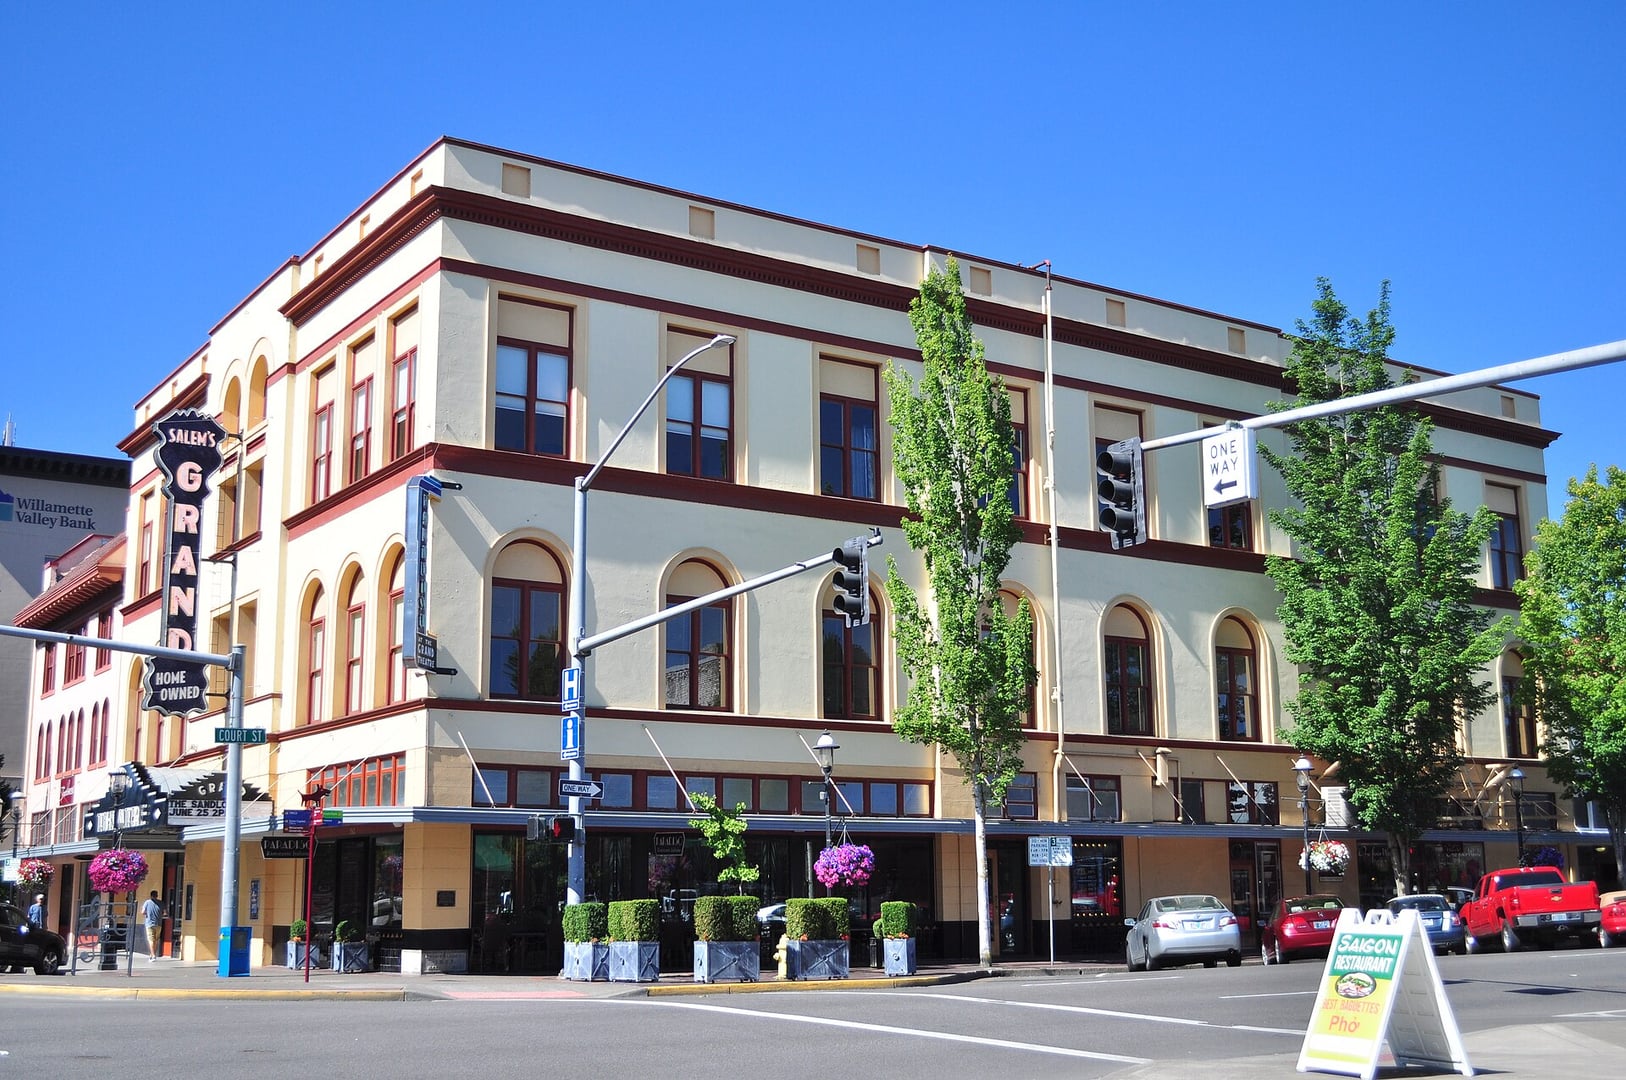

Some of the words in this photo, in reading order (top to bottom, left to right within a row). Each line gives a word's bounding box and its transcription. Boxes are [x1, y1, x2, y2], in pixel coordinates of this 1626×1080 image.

[168, 428, 216, 448] SALEM'S
[1211, 439, 1237, 459] ONE
[1210, 456, 1238, 476] WAY
[16, 497, 93, 516] Willamette
[16, 511, 57, 529] Valley
[59, 515, 96, 530] Bank
[167, 461, 203, 651] GRAND
[417, 643, 435, 658] GRAND
[155, 670, 187, 686] HOME
[160, 685, 200, 701] OWNED
[218, 729, 247, 742] COURT
[251, 730, 262, 742] ST
[563, 784, 576, 793] ONE
[577, 785, 590, 794] WAY
[169, 800, 187, 808] THE
[191, 800, 227, 808] SANDLO
[169, 809, 193, 817] JUNE
[197, 809, 209, 817] 25
[212, 809, 226, 817] 2P
[1338, 934, 1398, 955] SAIGON
[1334, 955, 1394, 973] RESTAURANT
[1322, 998, 1338, 1010] BEST
[1341, 999, 1381, 1015] BAGUETTES
